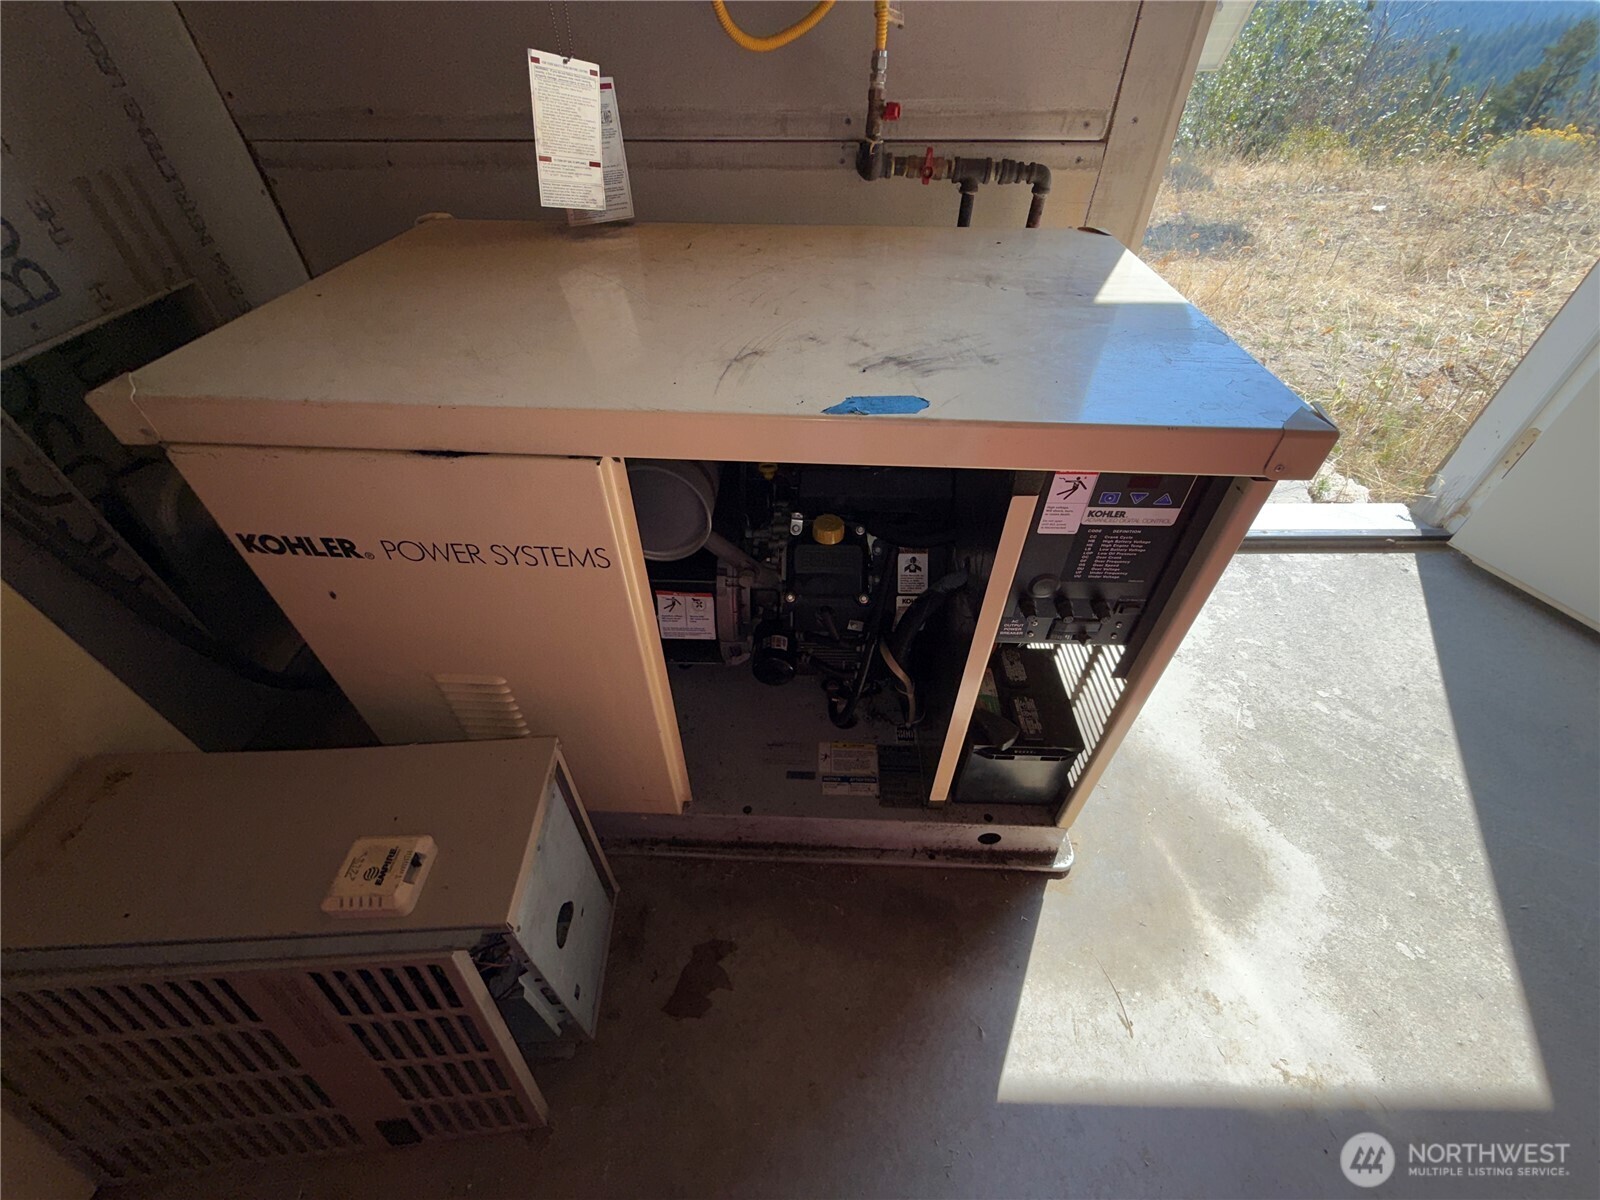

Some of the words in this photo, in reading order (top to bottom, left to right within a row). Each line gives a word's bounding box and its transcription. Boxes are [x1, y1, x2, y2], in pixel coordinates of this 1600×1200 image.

[380, 539, 487, 565] POWER
[494, 543, 612, 569] SYSTEMS
[374, 847, 398, 886] EMPIRE
